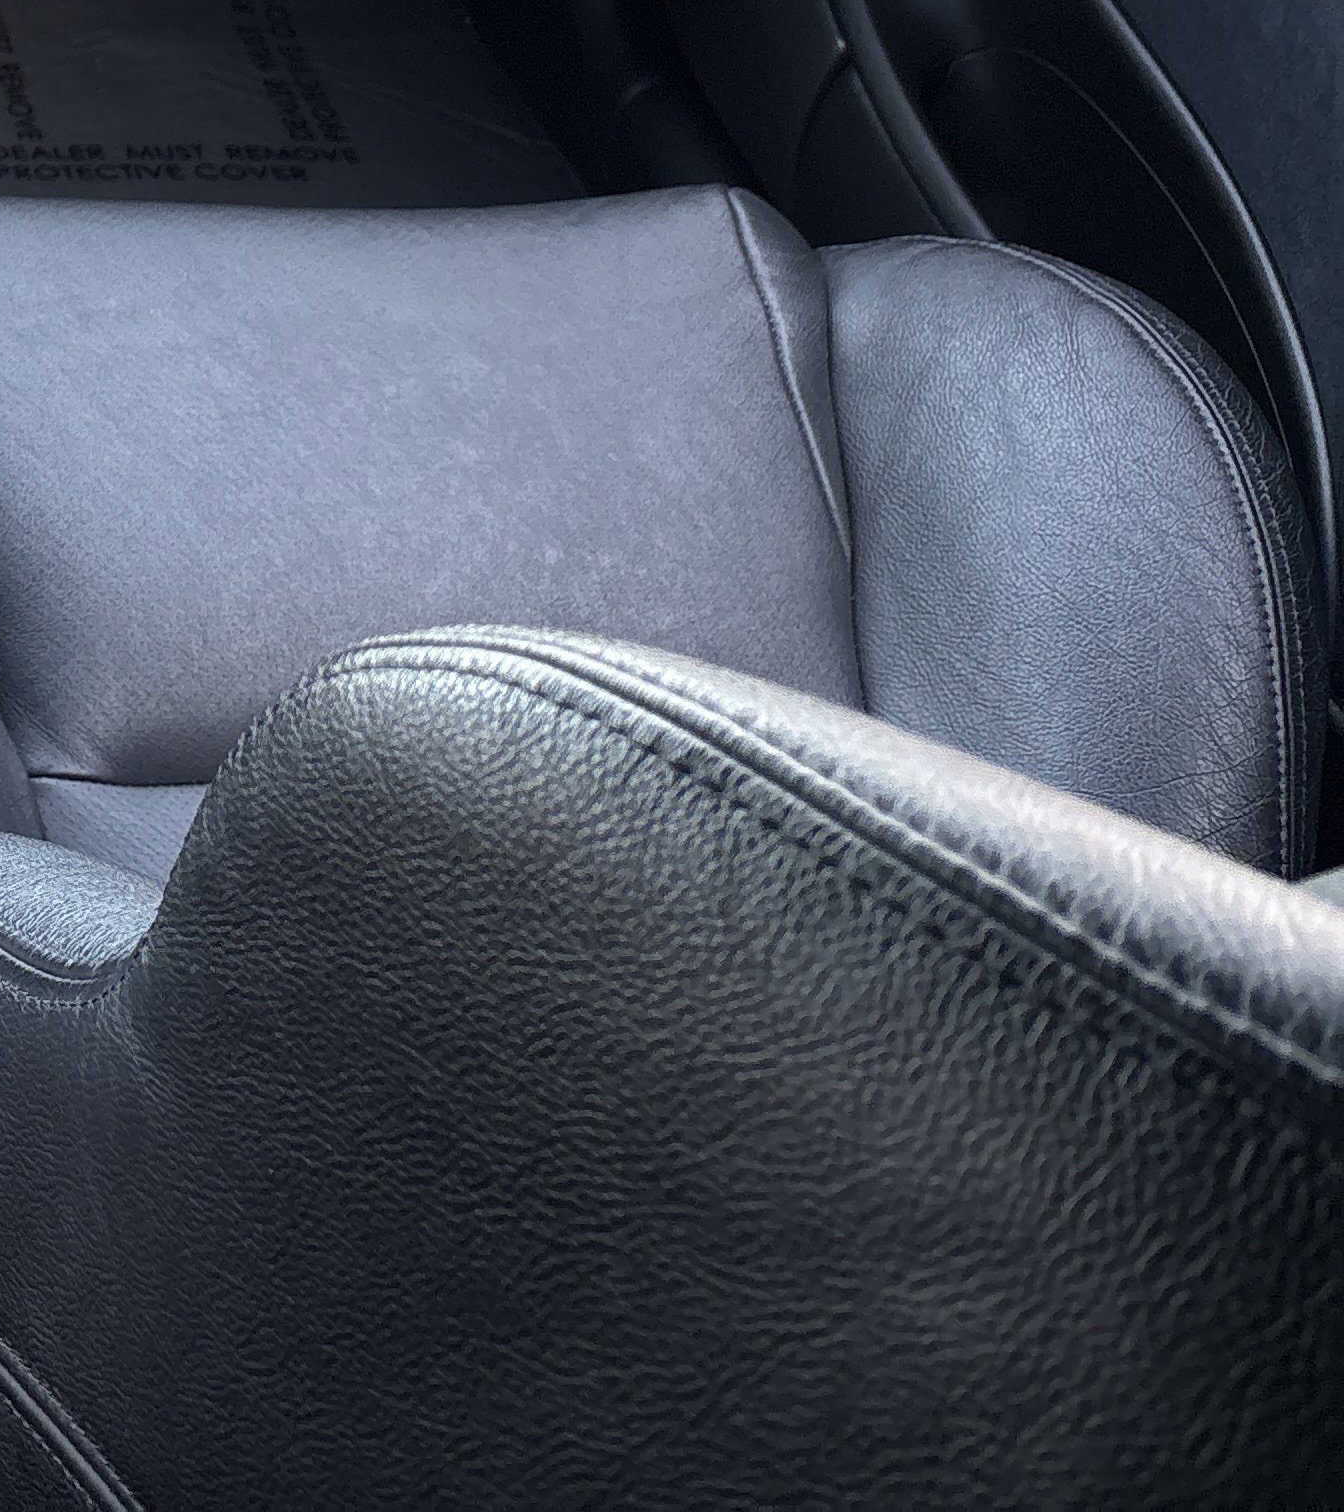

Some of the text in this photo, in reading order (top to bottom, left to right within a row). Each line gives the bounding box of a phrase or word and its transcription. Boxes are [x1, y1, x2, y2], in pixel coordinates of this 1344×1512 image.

[125, 143, 204, 161] MUST
[225, 143, 361, 165] REMOVE
[193, 163, 311, 183] COVER
